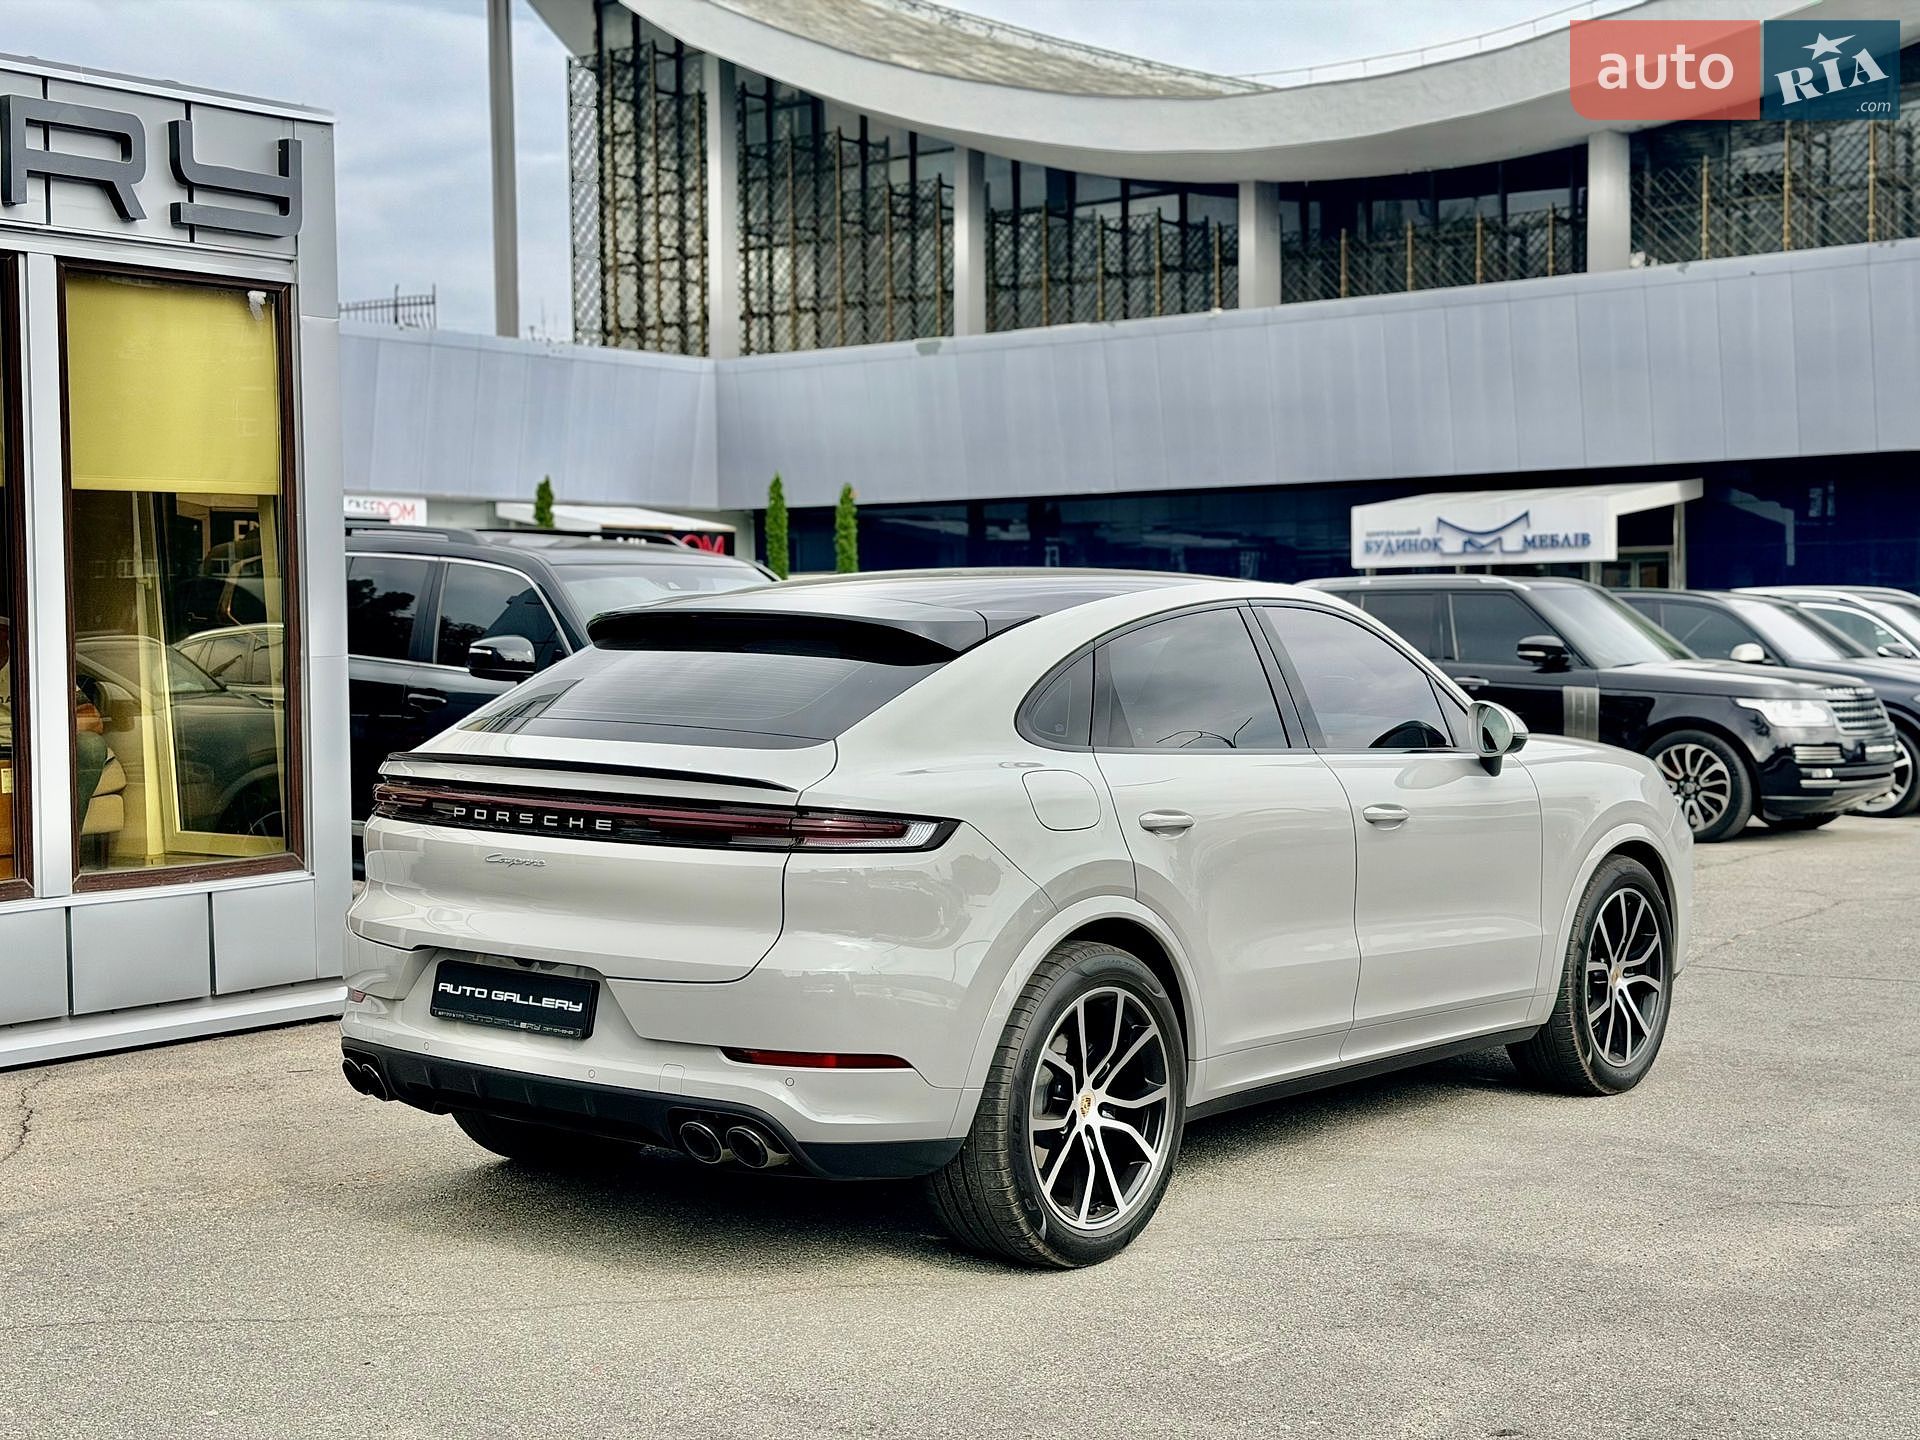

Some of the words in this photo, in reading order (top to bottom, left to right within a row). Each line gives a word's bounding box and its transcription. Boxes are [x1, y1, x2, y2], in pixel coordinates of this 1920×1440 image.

[1364, 537, 1443, 557] БУДИНОК
[1522, 533, 1591, 550] МЕБЛІВ
[453, 807, 612, 831] PORSCHE
[485, 853, 547, 868] Cayenne
[438, 982, 488, 999] AUTO
[491, 990, 583, 1013] GALLERY
